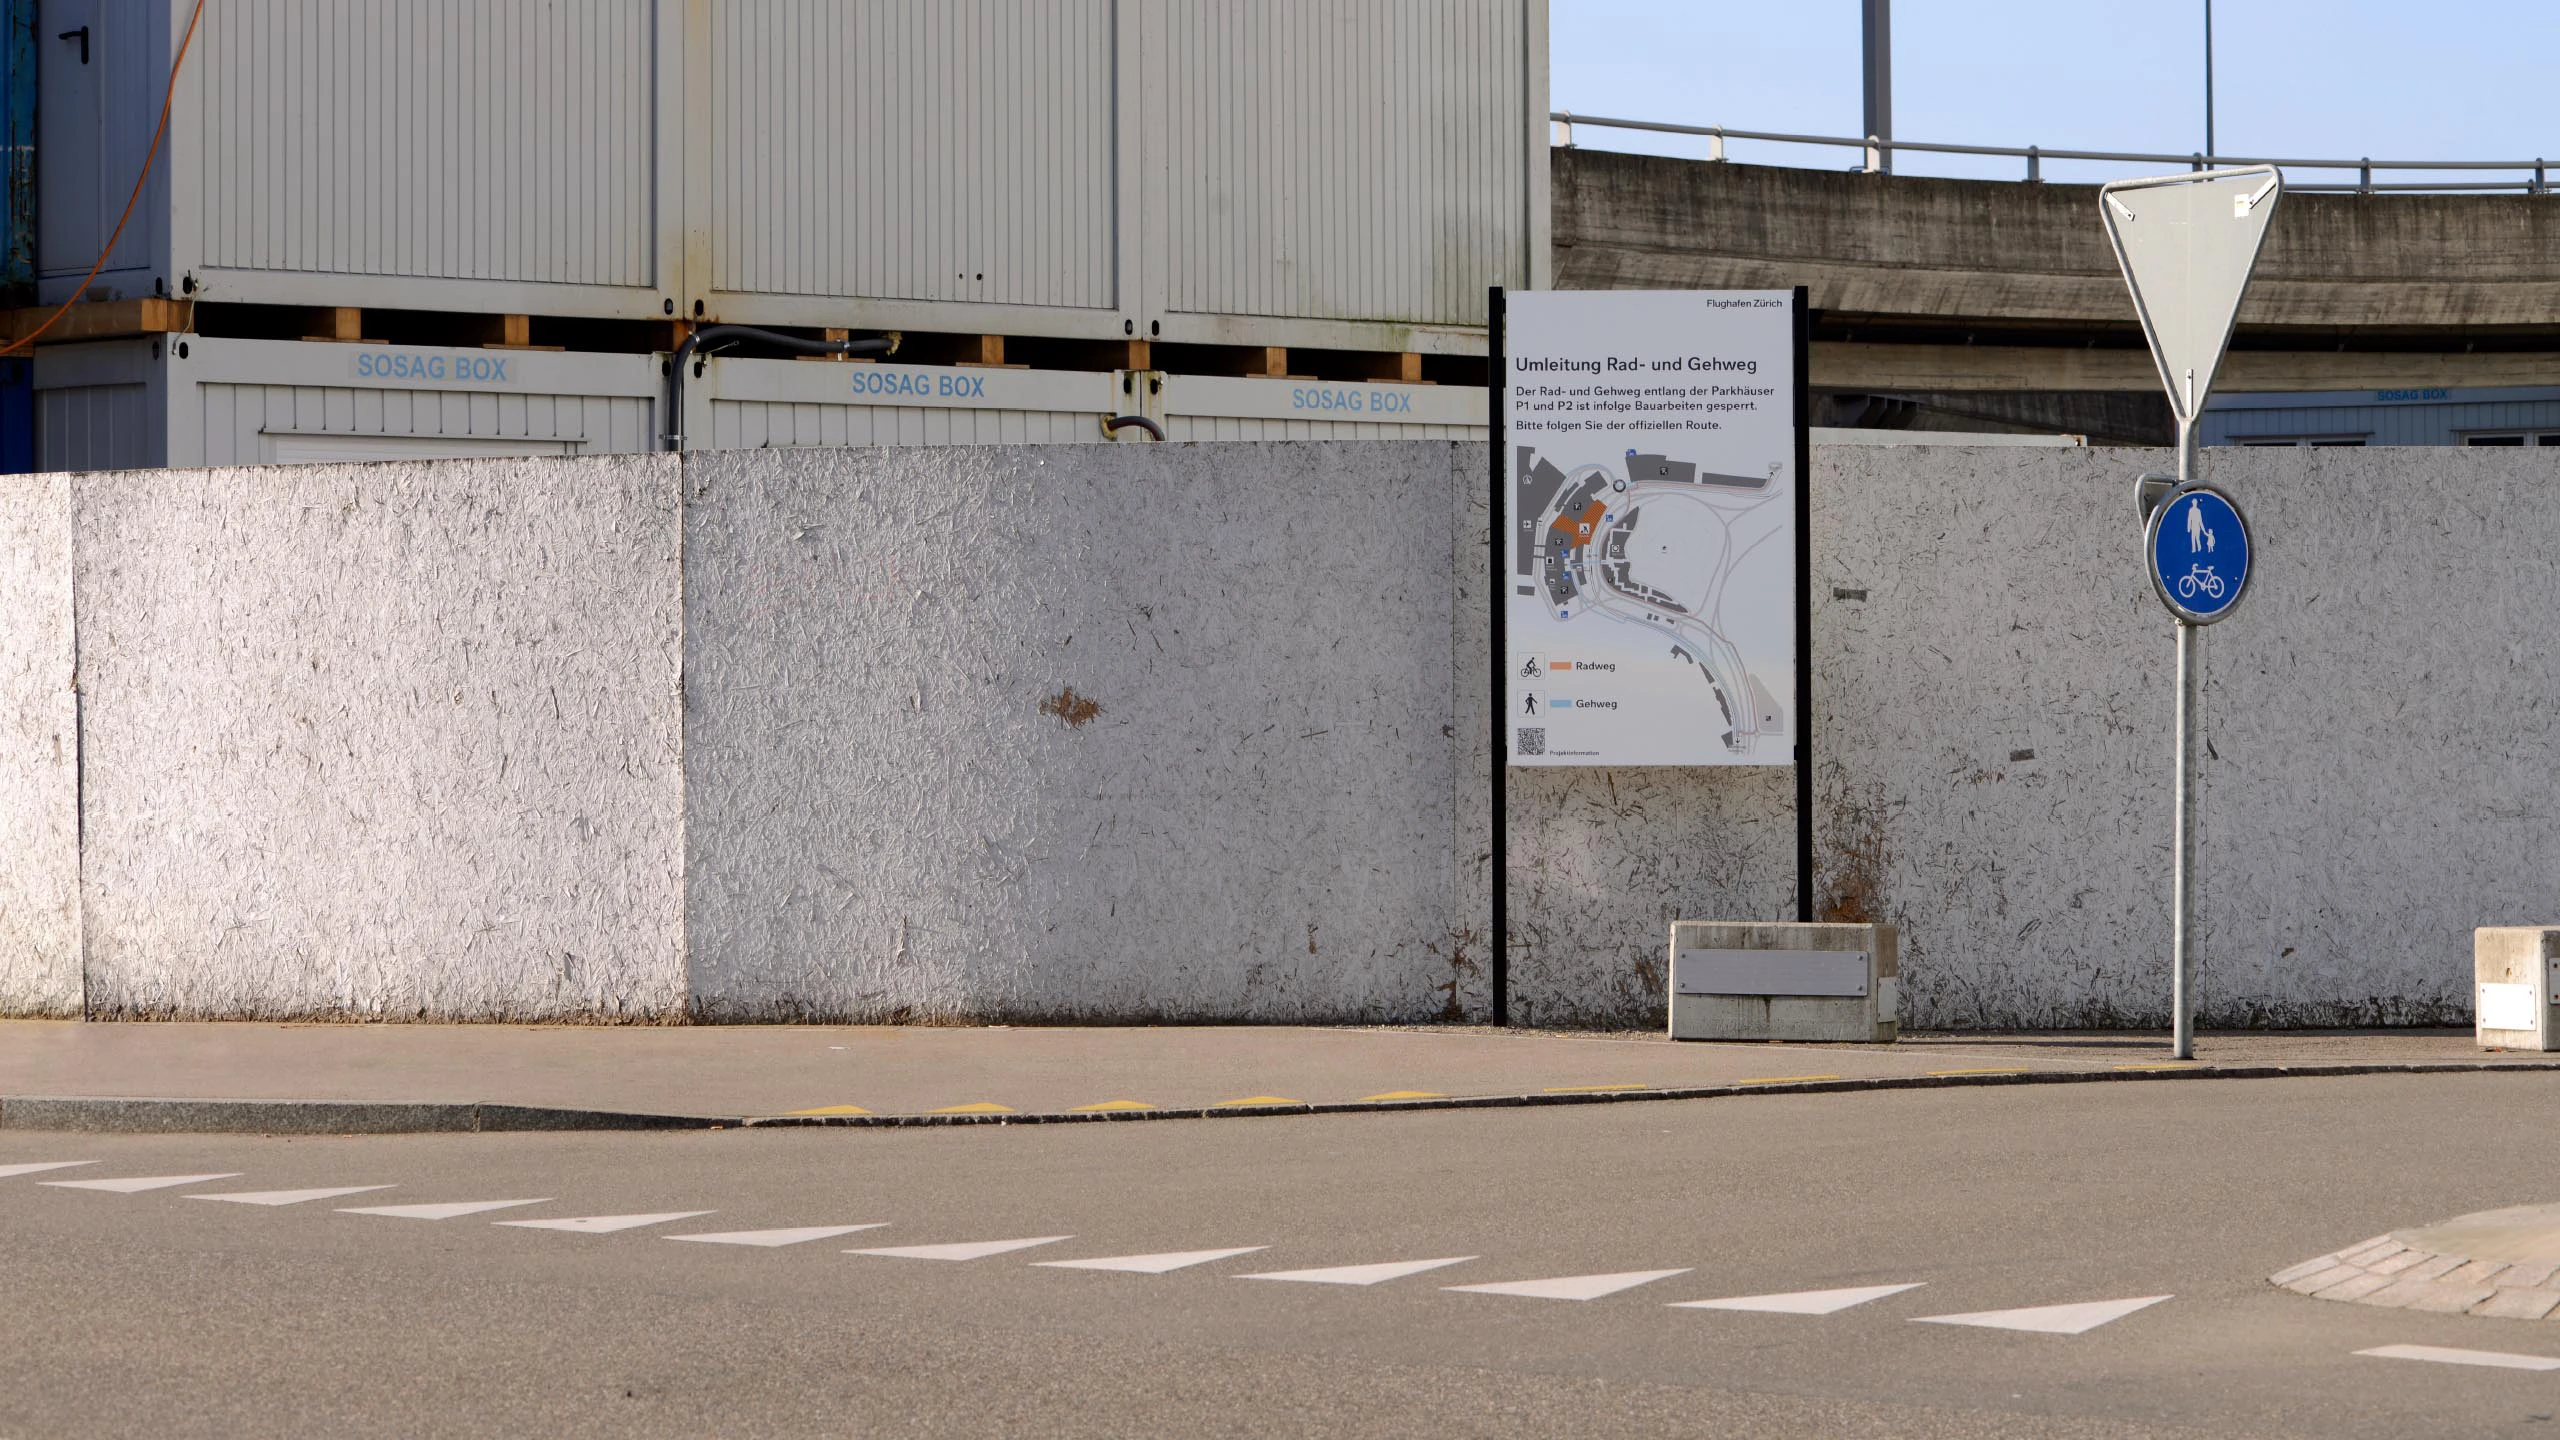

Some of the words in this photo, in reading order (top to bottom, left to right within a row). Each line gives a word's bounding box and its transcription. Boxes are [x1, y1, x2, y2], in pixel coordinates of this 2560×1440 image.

[1707, 299, 1751, 309] Flughafen
[1754, 299, 1782, 308] Zürich
[358, 353, 446, 379] SOSAG
[456, 357, 507, 381] BOX
[1516, 357, 1600, 374] Umleitung
[1608, 357, 1645, 371] Rad-
[1652, 357, 1681, 371] und
[1688, 357, 1756, 374] Gehweg
[853, 372, 930, 396] SOSAG
[939, 374, 984, 397] BOX
[1517, 387, 1536, 397] Der
[1540, 386, 1566, 397] Rad-
[1570, 386, 1590, 397] und
[1594, 386, 1640, 399] Gehweg
[1645, 386, 1685, 399] entlang
[1690, 386, 1708, 396] der
[1712, 386, 1774, 396] Parkhäuser
[2377, 389, 2418, 401] SOSAG
[2423, 388, 2448, 400] BOX
[1293, 388, 1362, 411] SOSAG
[1370, 391, 1411, 413] BOX
[1517, 401, 1528, 411] P1
[1534, 401, 1553, 411] und
[1558, 401, 1572, 411] P2
[1577, 402, 1589, 411] ist
[1594, 401, 1631, 413] infolge
[1636, 401, 1702, 411] Bauarbeiten
[1707, 402, 1757, 413] gesperrt.
[1517, 421, 1542, 431] Bitte
[1547, 421, 1581, 433] folgen
[1585, 421, 1602, 430] Sie
[1607, 421, 1625, 430] der
[1629, 421, 1682, 430] offiziellen
[1686, 420, 1721, 430] Route.
[1576, 662, 1615, 673] Radweg
[1576, 700, 1617, 711] Gehweg
